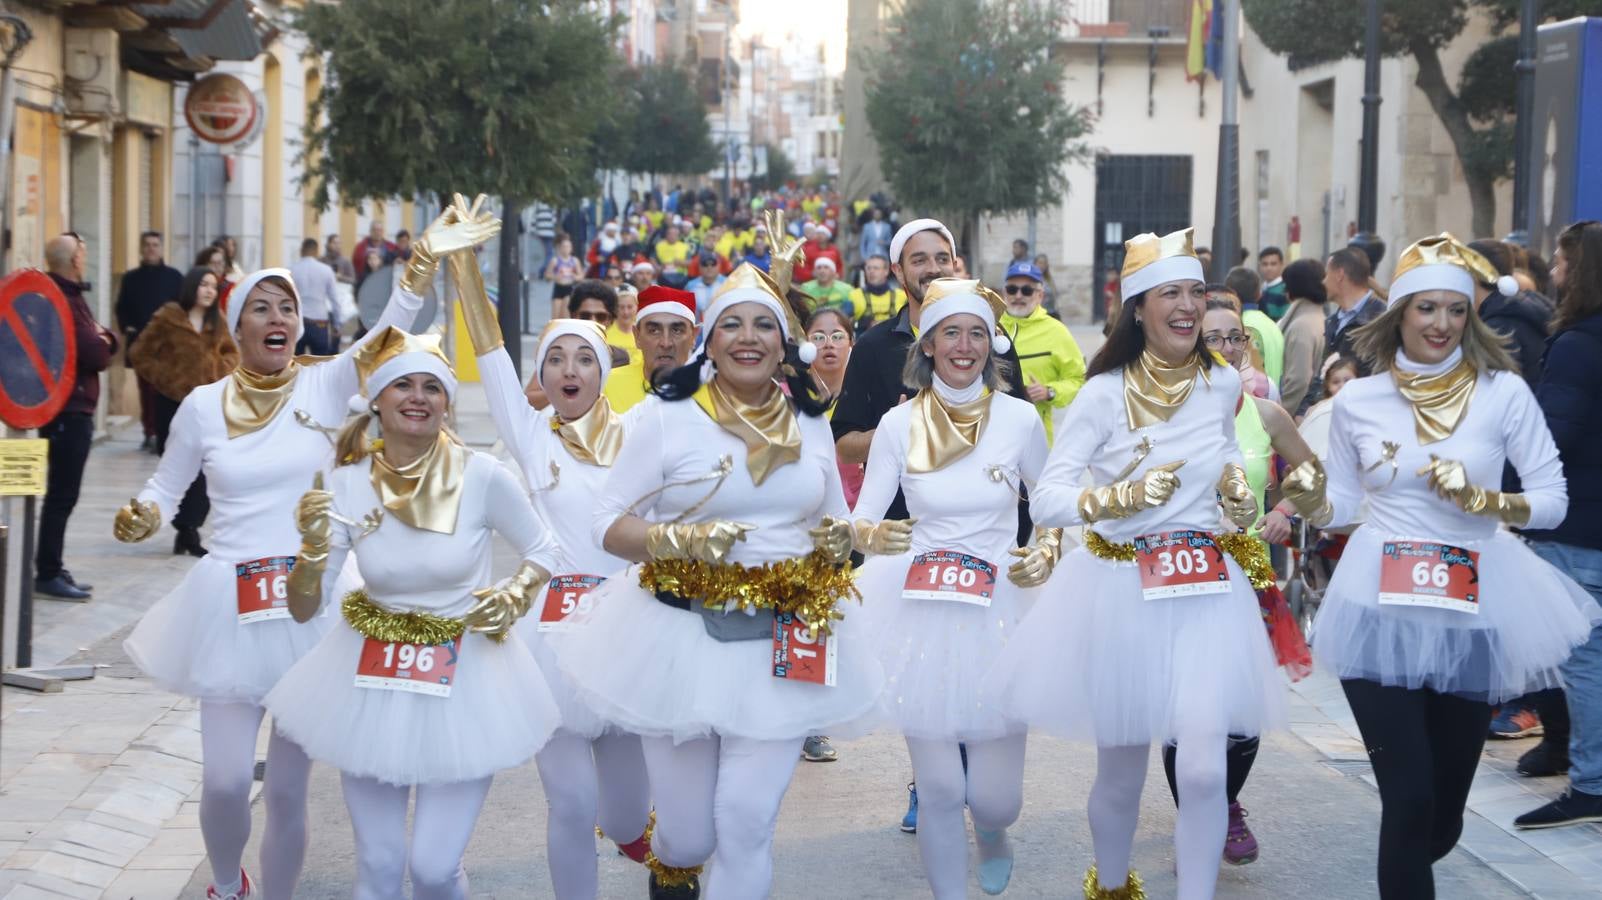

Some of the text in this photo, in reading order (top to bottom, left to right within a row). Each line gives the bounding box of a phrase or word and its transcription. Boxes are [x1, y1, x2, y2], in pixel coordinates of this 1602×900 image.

[928, 566, 976, 587] 160
[1158, 549, 1209, 577] 303
[1412, 561, 1449, 587] 66
[383, 643, 435, 672] 196
